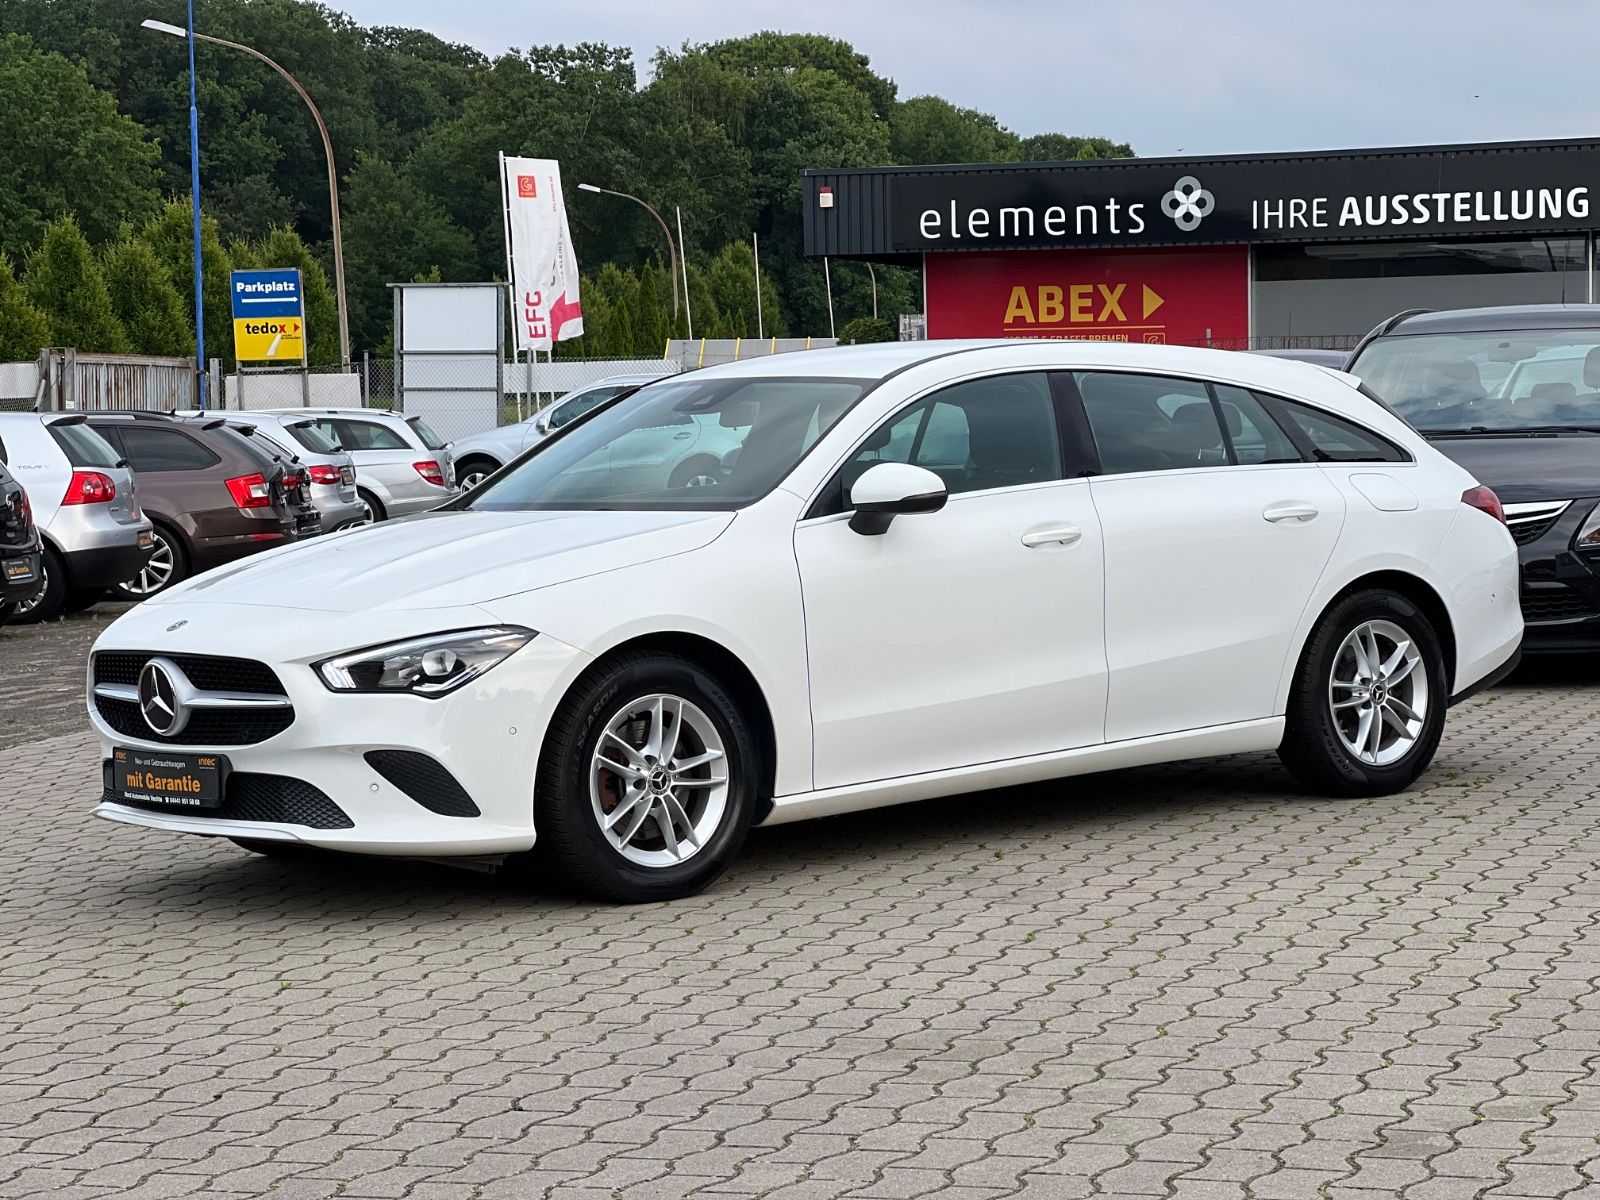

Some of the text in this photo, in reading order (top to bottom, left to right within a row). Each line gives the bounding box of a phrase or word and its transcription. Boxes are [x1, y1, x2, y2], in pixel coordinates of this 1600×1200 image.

[919, 197, 1145, 239] elements
[1252, 187, 1590, 229] IHRE AUSSTELLUNG
[236, 281, 295, 293] Parkplatz
[525, 291, 547, 338] EFG
[1003, 283, 1128, 324] ABEX
[245, 322, 287, 334] tedox
[151, 758, 186, 769] Gebrauchtwagen
[126, 771, 201, 793] mit Garantie
